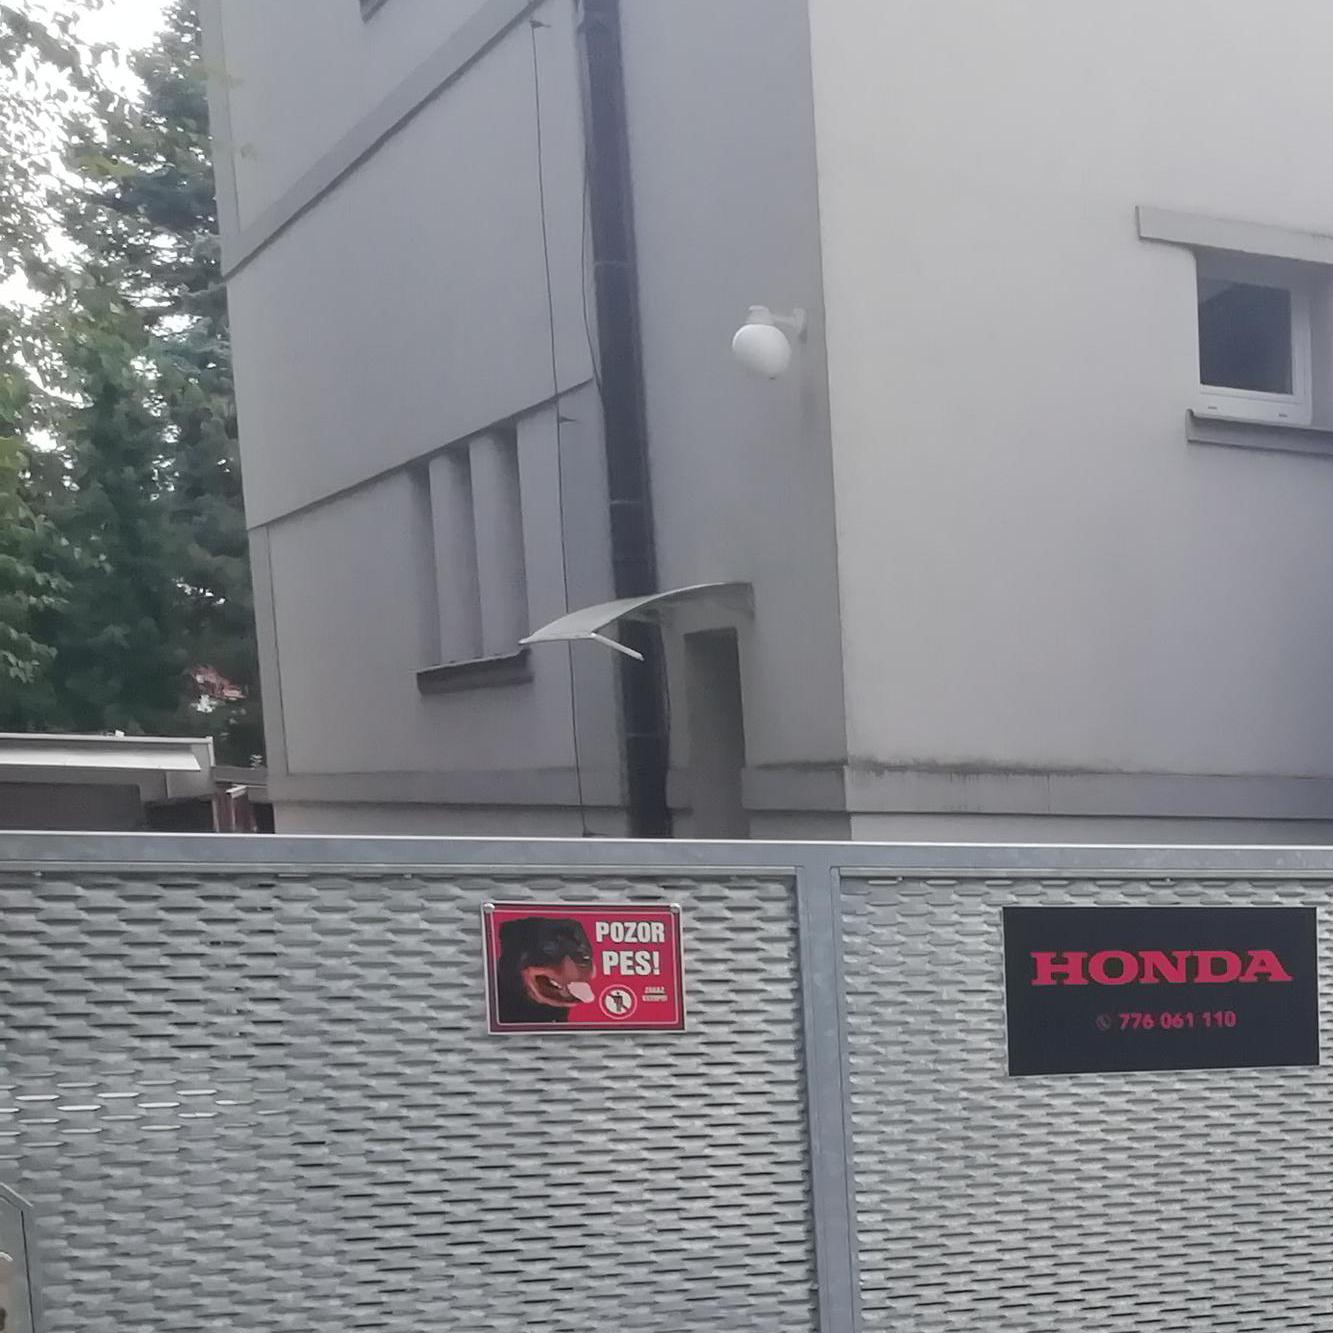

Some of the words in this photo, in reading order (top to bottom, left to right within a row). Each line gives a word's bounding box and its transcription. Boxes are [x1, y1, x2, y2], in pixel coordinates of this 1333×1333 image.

[595, 921, 665, 943] POZOR
[602, 951, 660, 975] PES!
[1029, 949, 1294, 986] HONDA
[1119, 1011, 1155, 1031] 776
[1160, 1010, 1194, 1030] 061
[1201, 1009, 1237, 1028] 110
